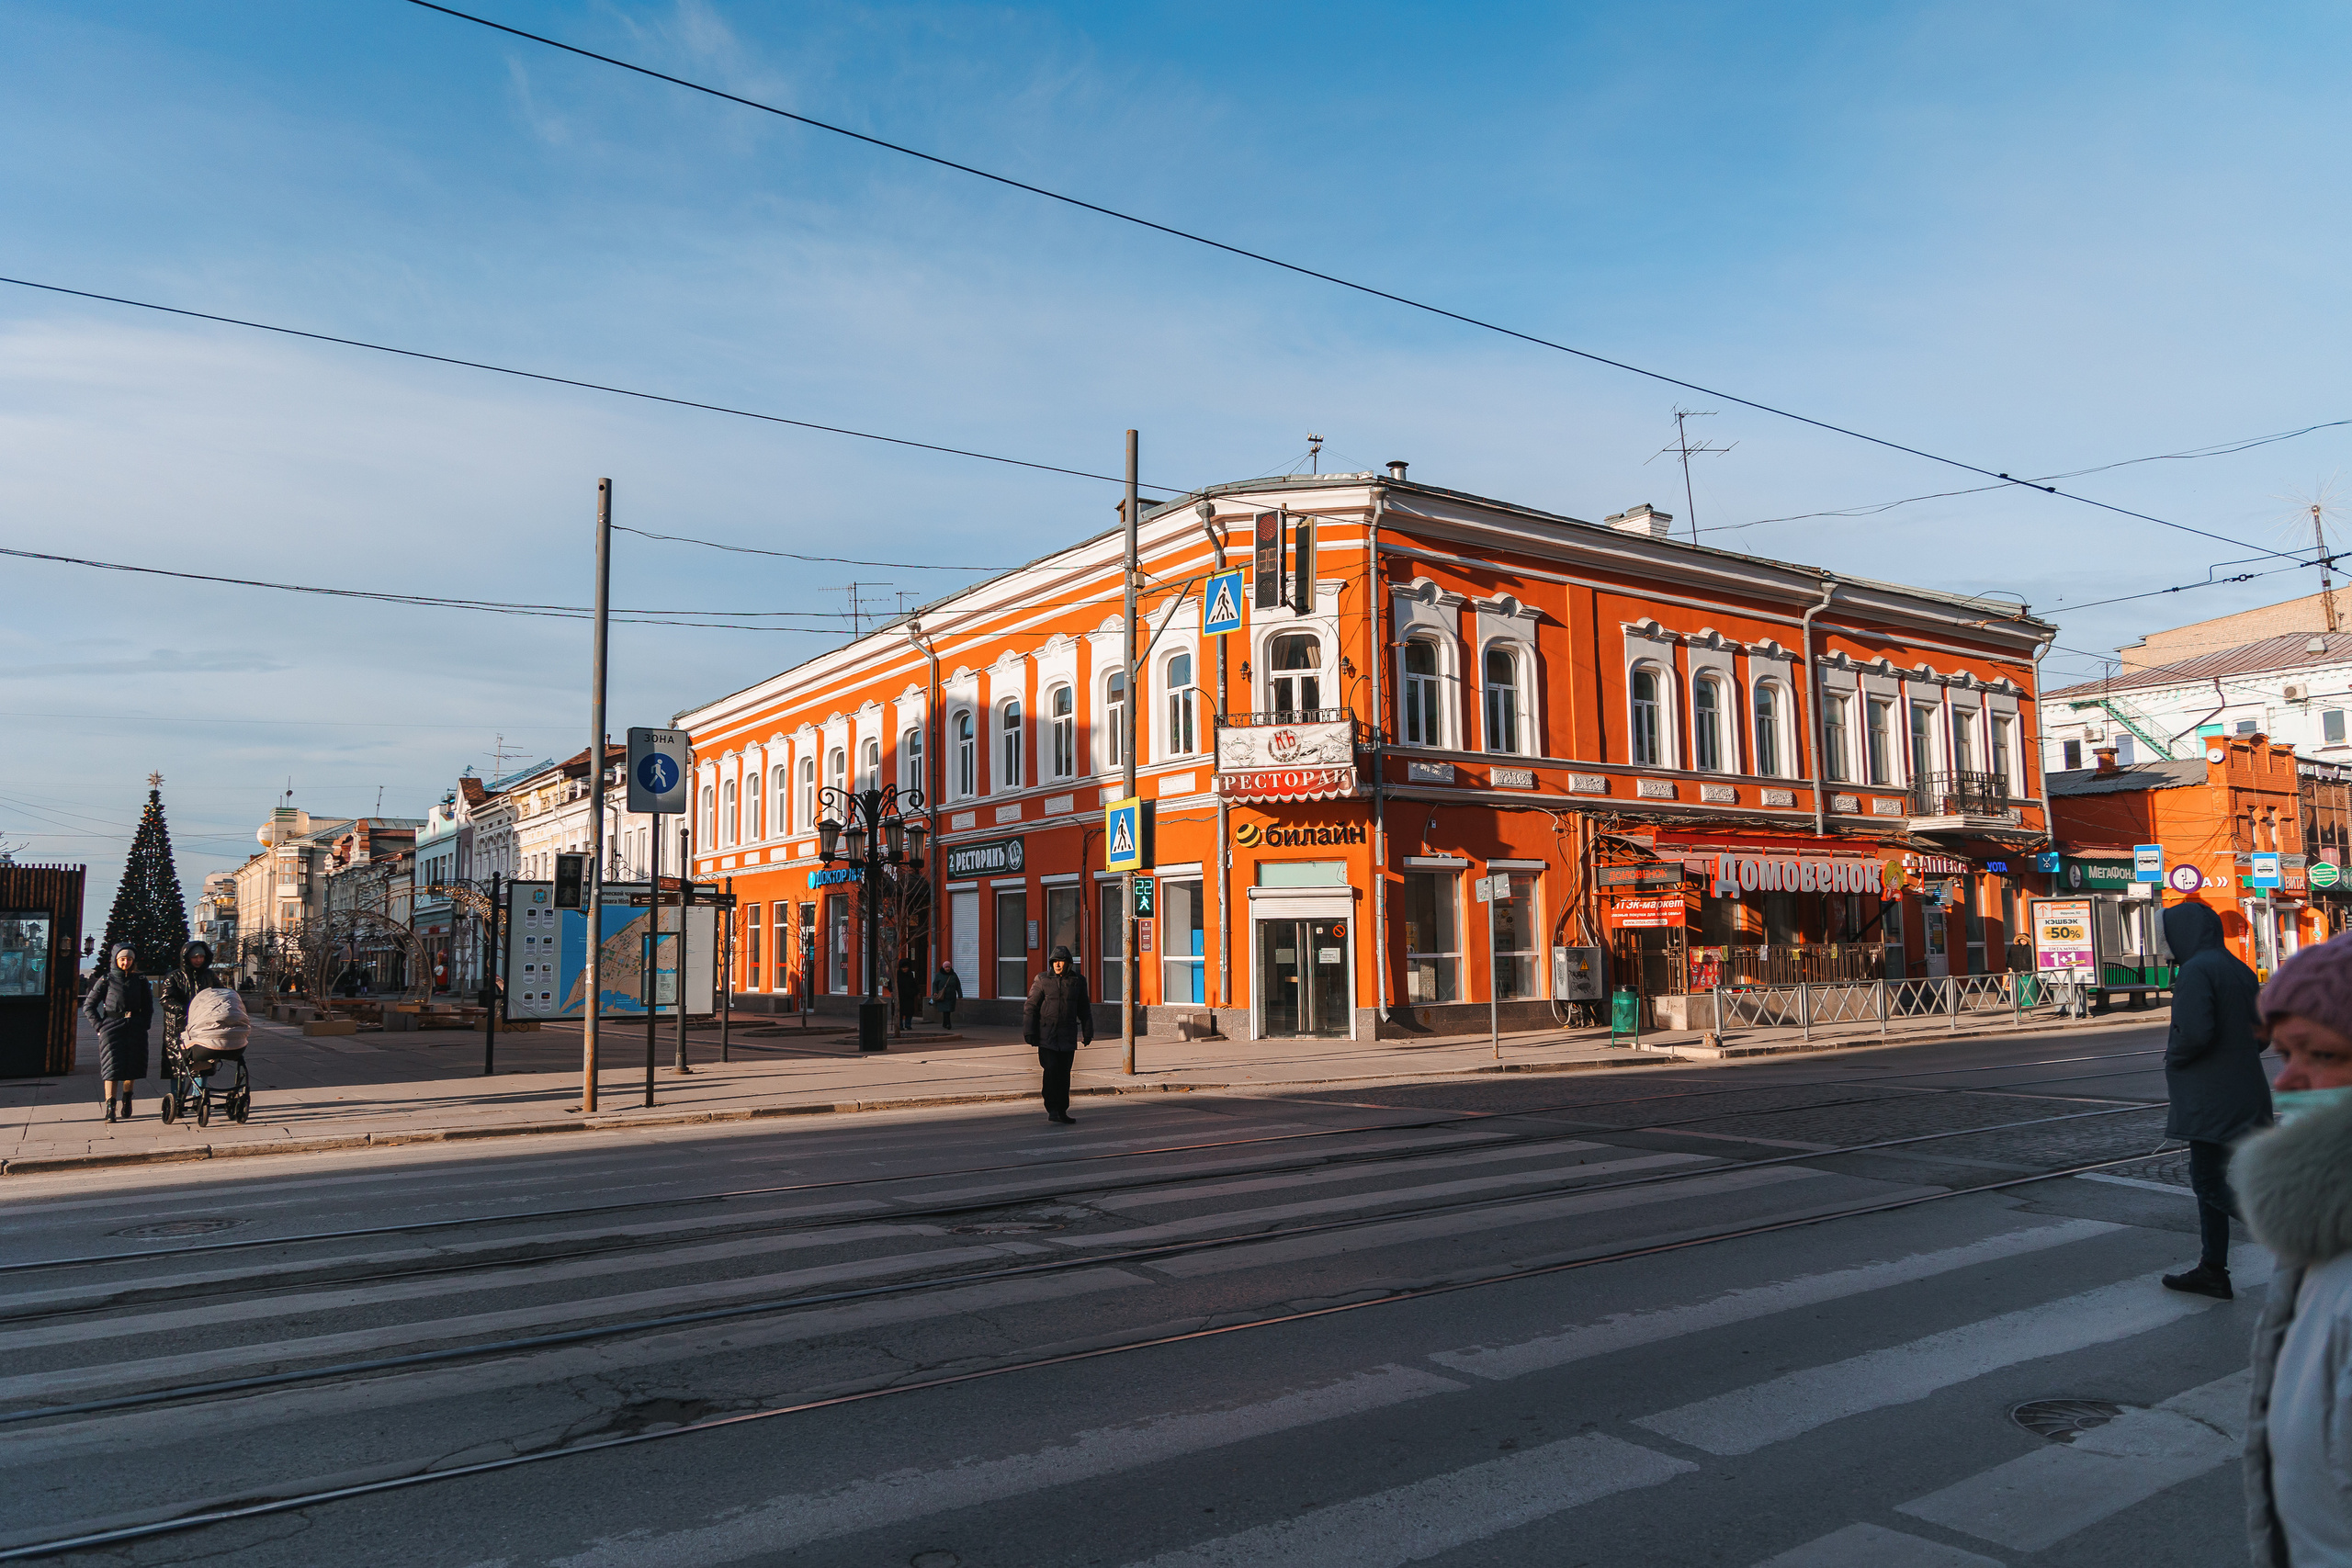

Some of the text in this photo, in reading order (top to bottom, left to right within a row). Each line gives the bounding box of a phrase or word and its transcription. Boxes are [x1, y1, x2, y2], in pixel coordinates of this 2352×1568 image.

[644, 734, 674, 744] ЗОНА
[1224, 769, 1348, 790] РЕСТОРАН
[1265, 820, 1366, 847] билайн
[949, 847, 1005, 872] 2 РЕСТОРАНЪ
[1918, 855, 1969, 874] АПТЕКА
[1986, 862, 2008, 873] YOTA
[815, 869, 847, 889] ДОКТОР
[1609, 869, 1668, 882] ДОМОВЕНОК
[2285, 875, 2305, 890] ВИТА
[1135, 880, 1153, 895] 22
[2051, 927, 2081, 939] 50%
[2050, 952, 2076, 967] 1+1
